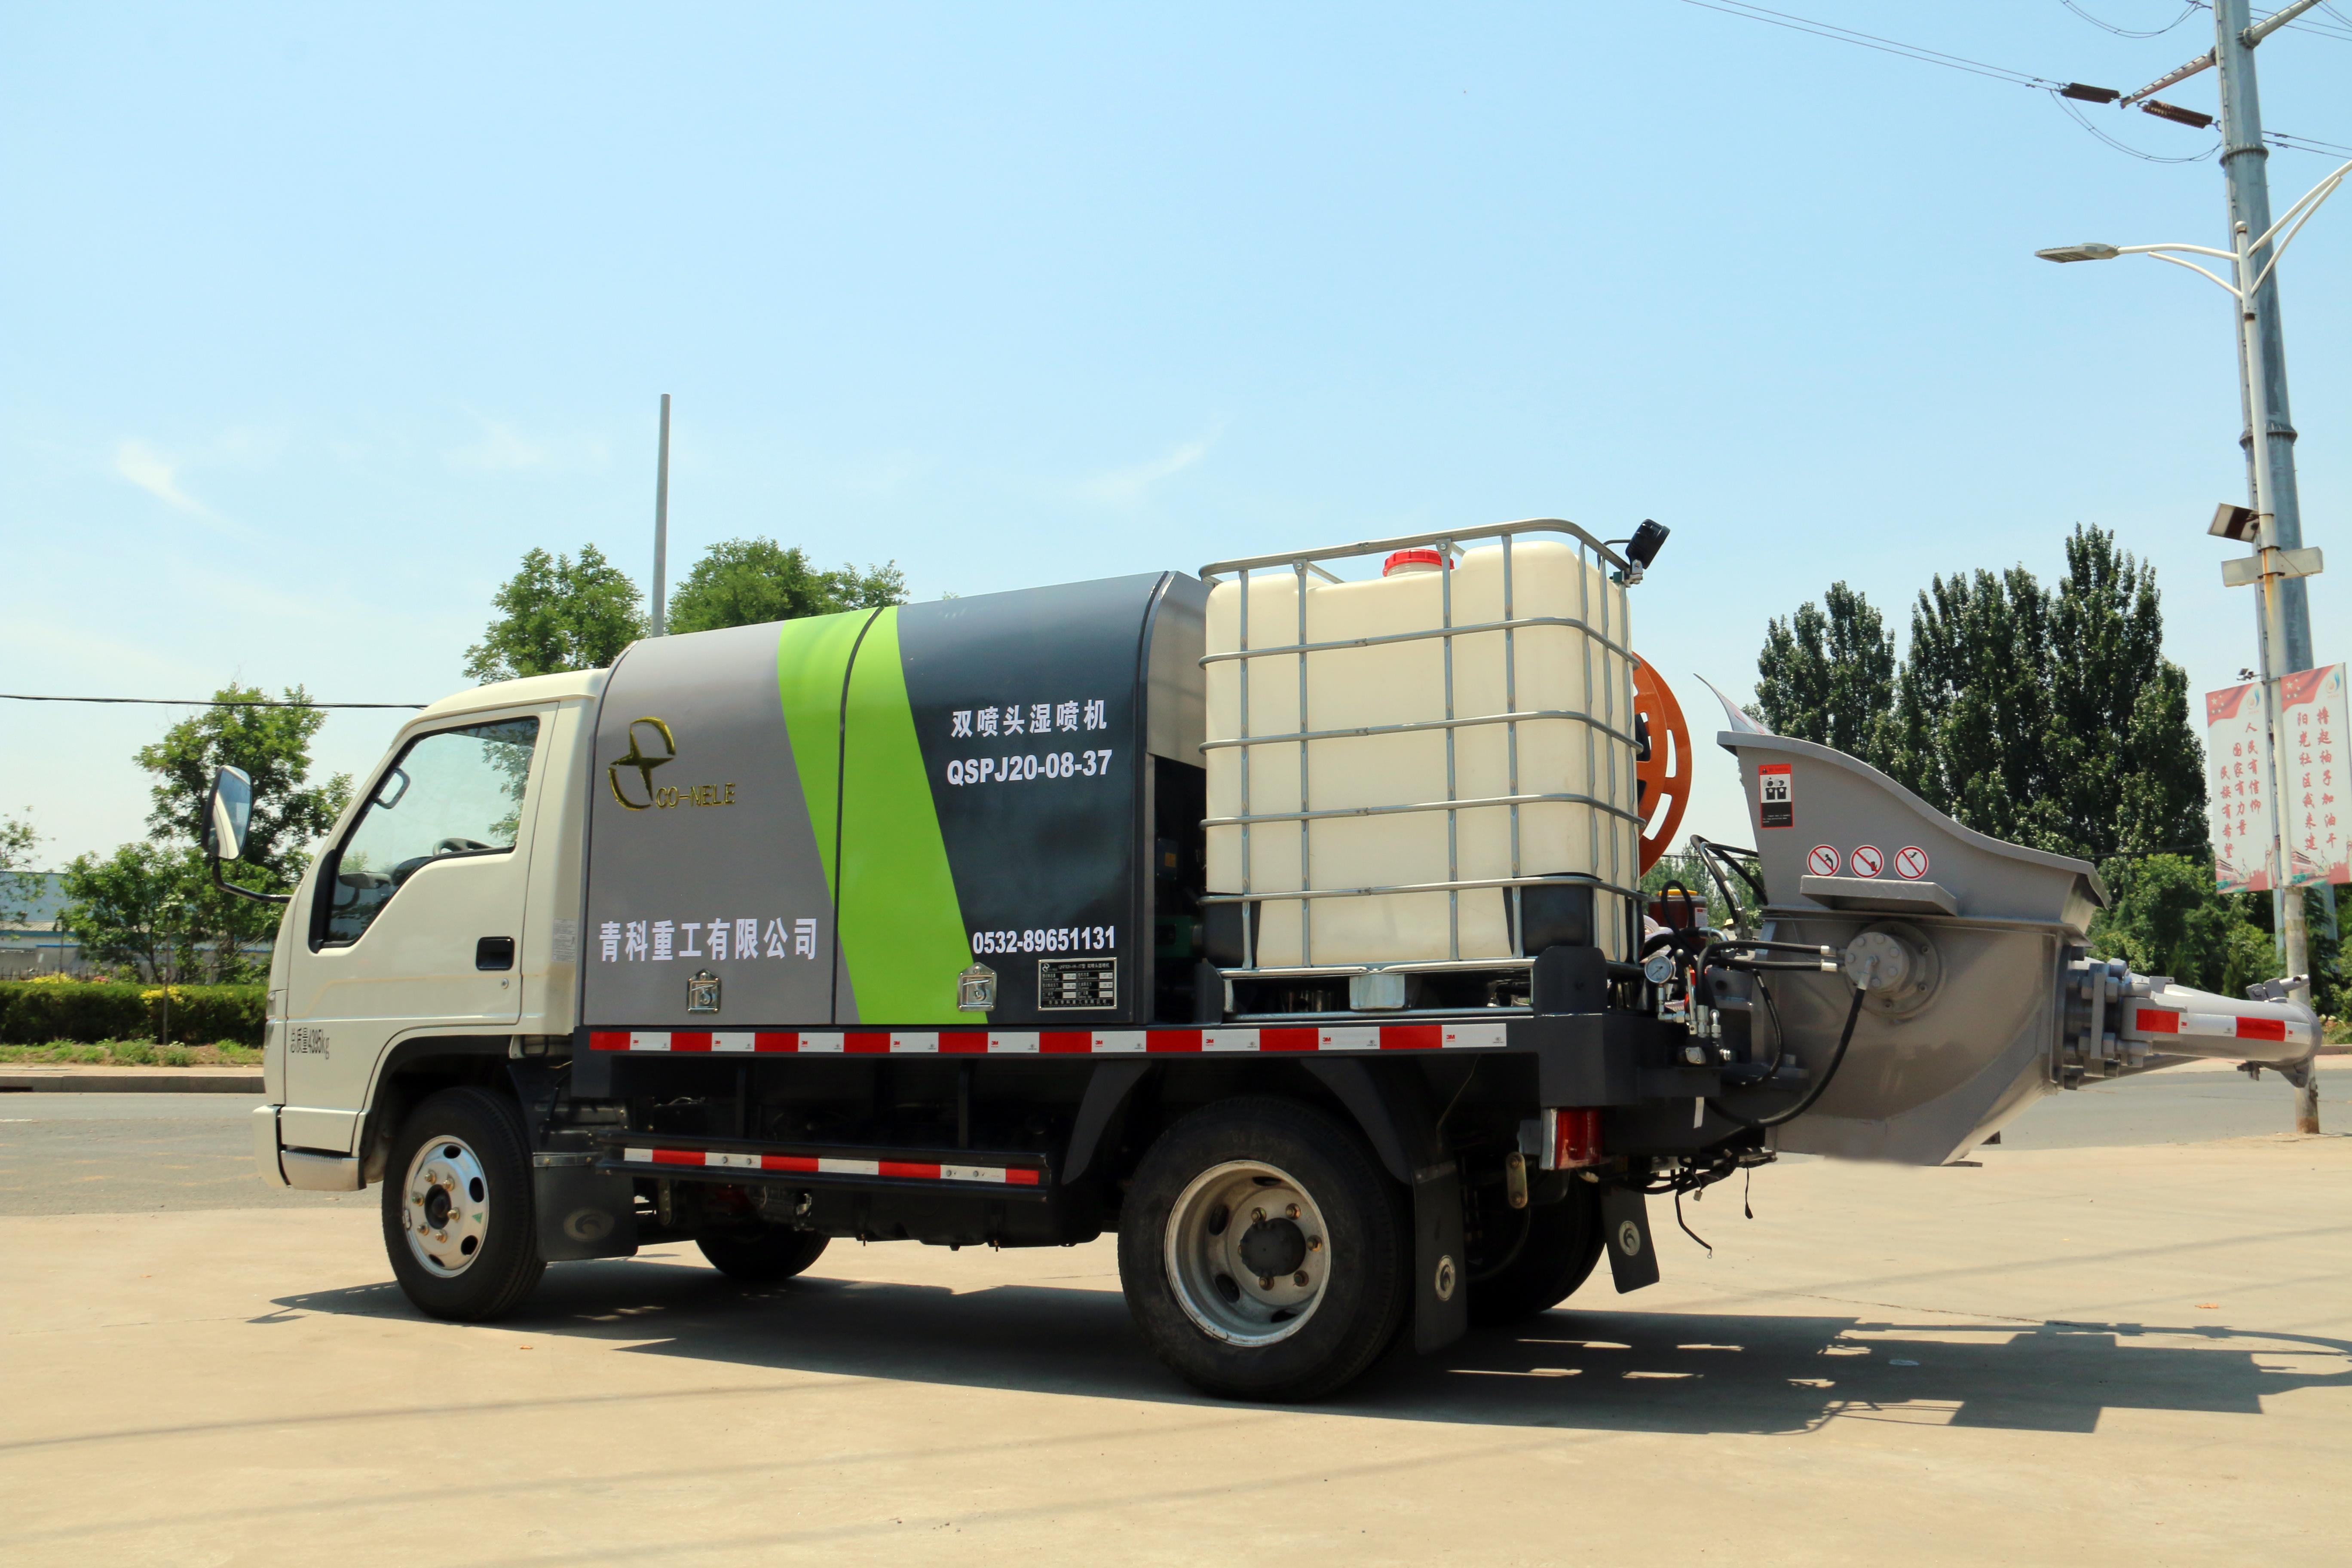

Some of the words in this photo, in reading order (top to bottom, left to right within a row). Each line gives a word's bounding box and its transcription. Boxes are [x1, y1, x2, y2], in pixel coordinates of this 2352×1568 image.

[951, 699, 1107, 738] 双喷头湿喷机
[656, 783, 735, 808] CO-NELE
[947, 750, 1112, 786] QSPJ20-08-37
[2233, 742, 2247, 836] 国家有力量
[2245, 722, 2261, 814] 人民有信仰
[2297, 711, 2318, 851] 阳光社区我来建
[2317, 706, 2337, 848] 撸起袖子加油干
[2220, 766, 2234, 858] 民族有希望
[599, 917, 817, 962] 青科重工有限公司
[973, 926, 1115, 954] 0532-89651131
